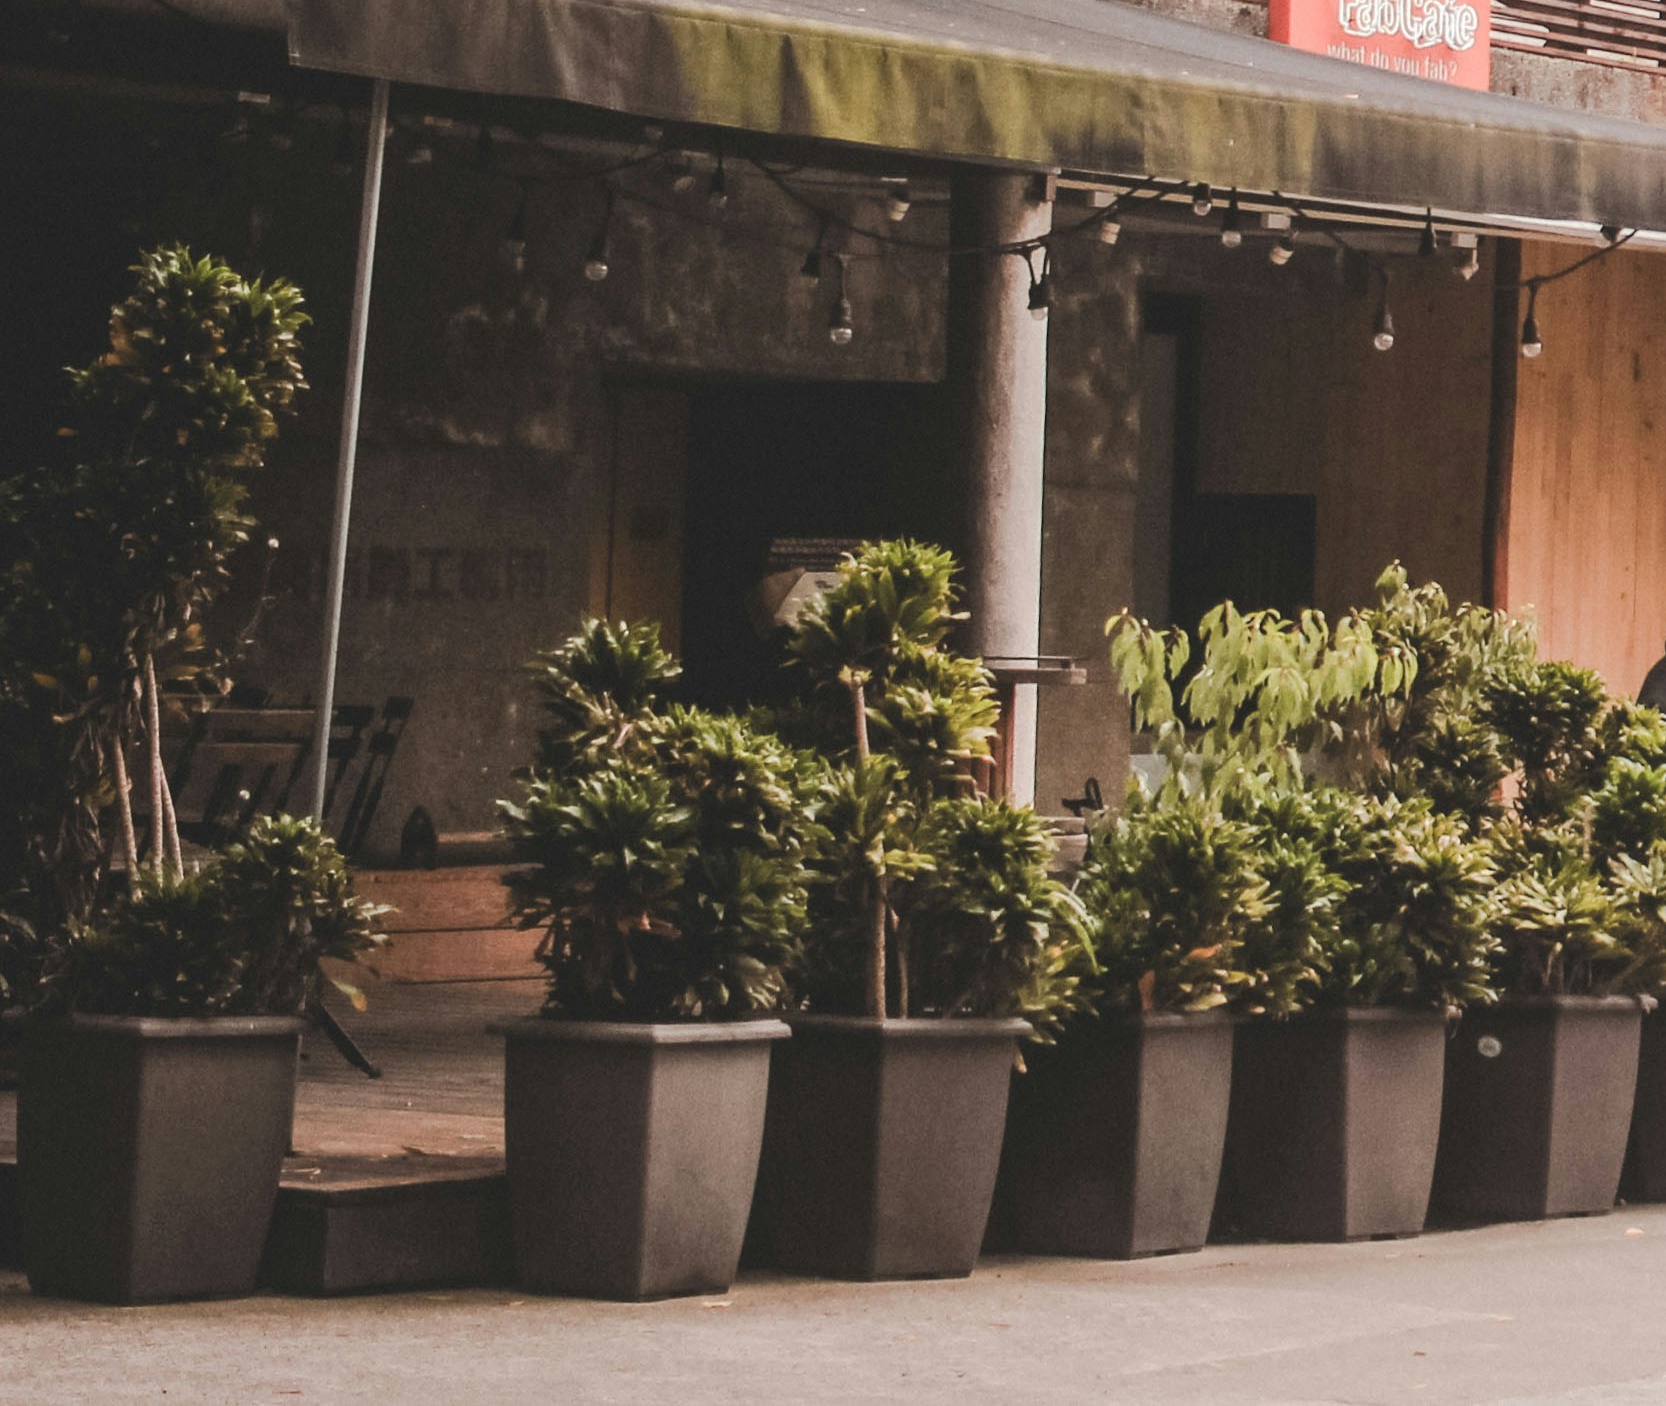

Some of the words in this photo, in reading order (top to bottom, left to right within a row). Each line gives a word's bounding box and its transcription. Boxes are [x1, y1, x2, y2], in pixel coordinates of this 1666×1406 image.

[1327, 42, 1365, 64] what
[1370, 48, 1389, 70] do
[1393, 55, 1419, 76] you
[1424, 56, 1458, 82] fab?
